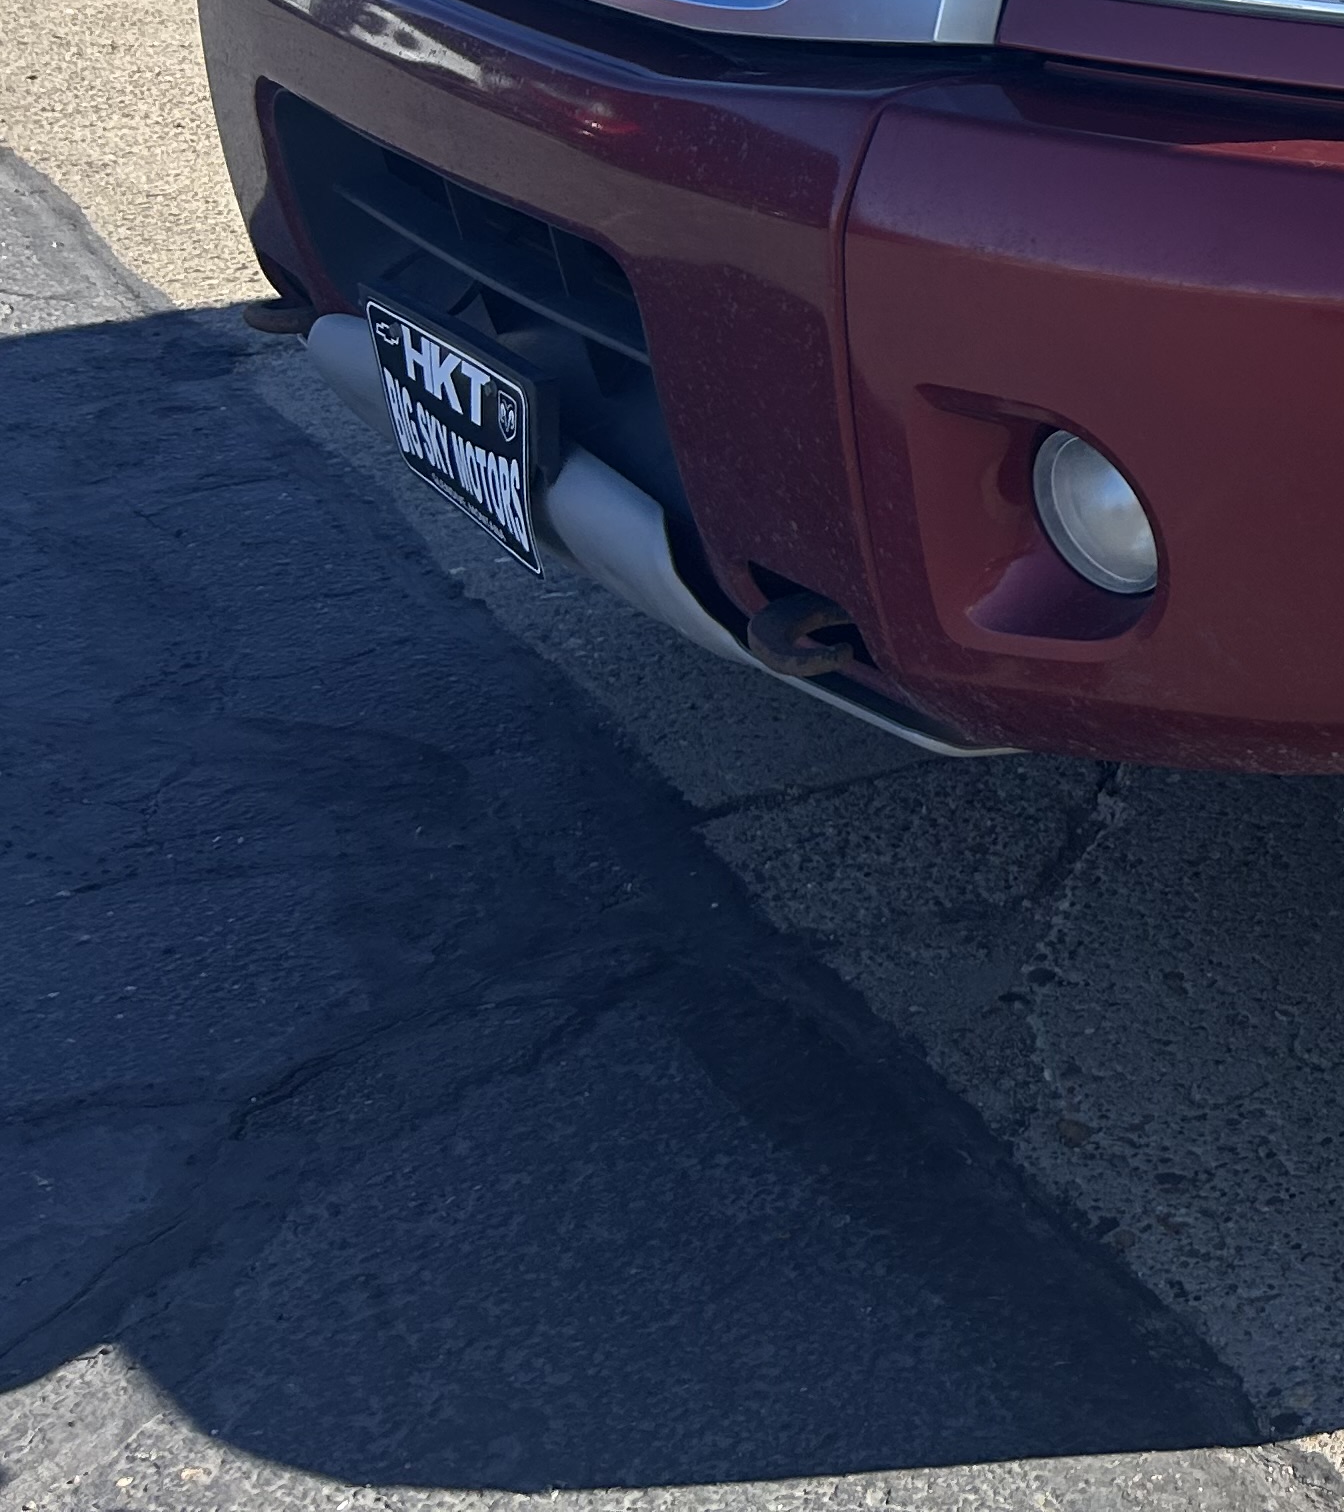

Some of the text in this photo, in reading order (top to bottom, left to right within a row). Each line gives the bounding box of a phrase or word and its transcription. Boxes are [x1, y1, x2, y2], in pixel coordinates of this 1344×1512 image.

[401, 323, 491, 427] HKT
[383, 366, 424, 460] BIG
[417, 401, 455, 480] SKY
[451, 430, 530, 553] MOTORS
